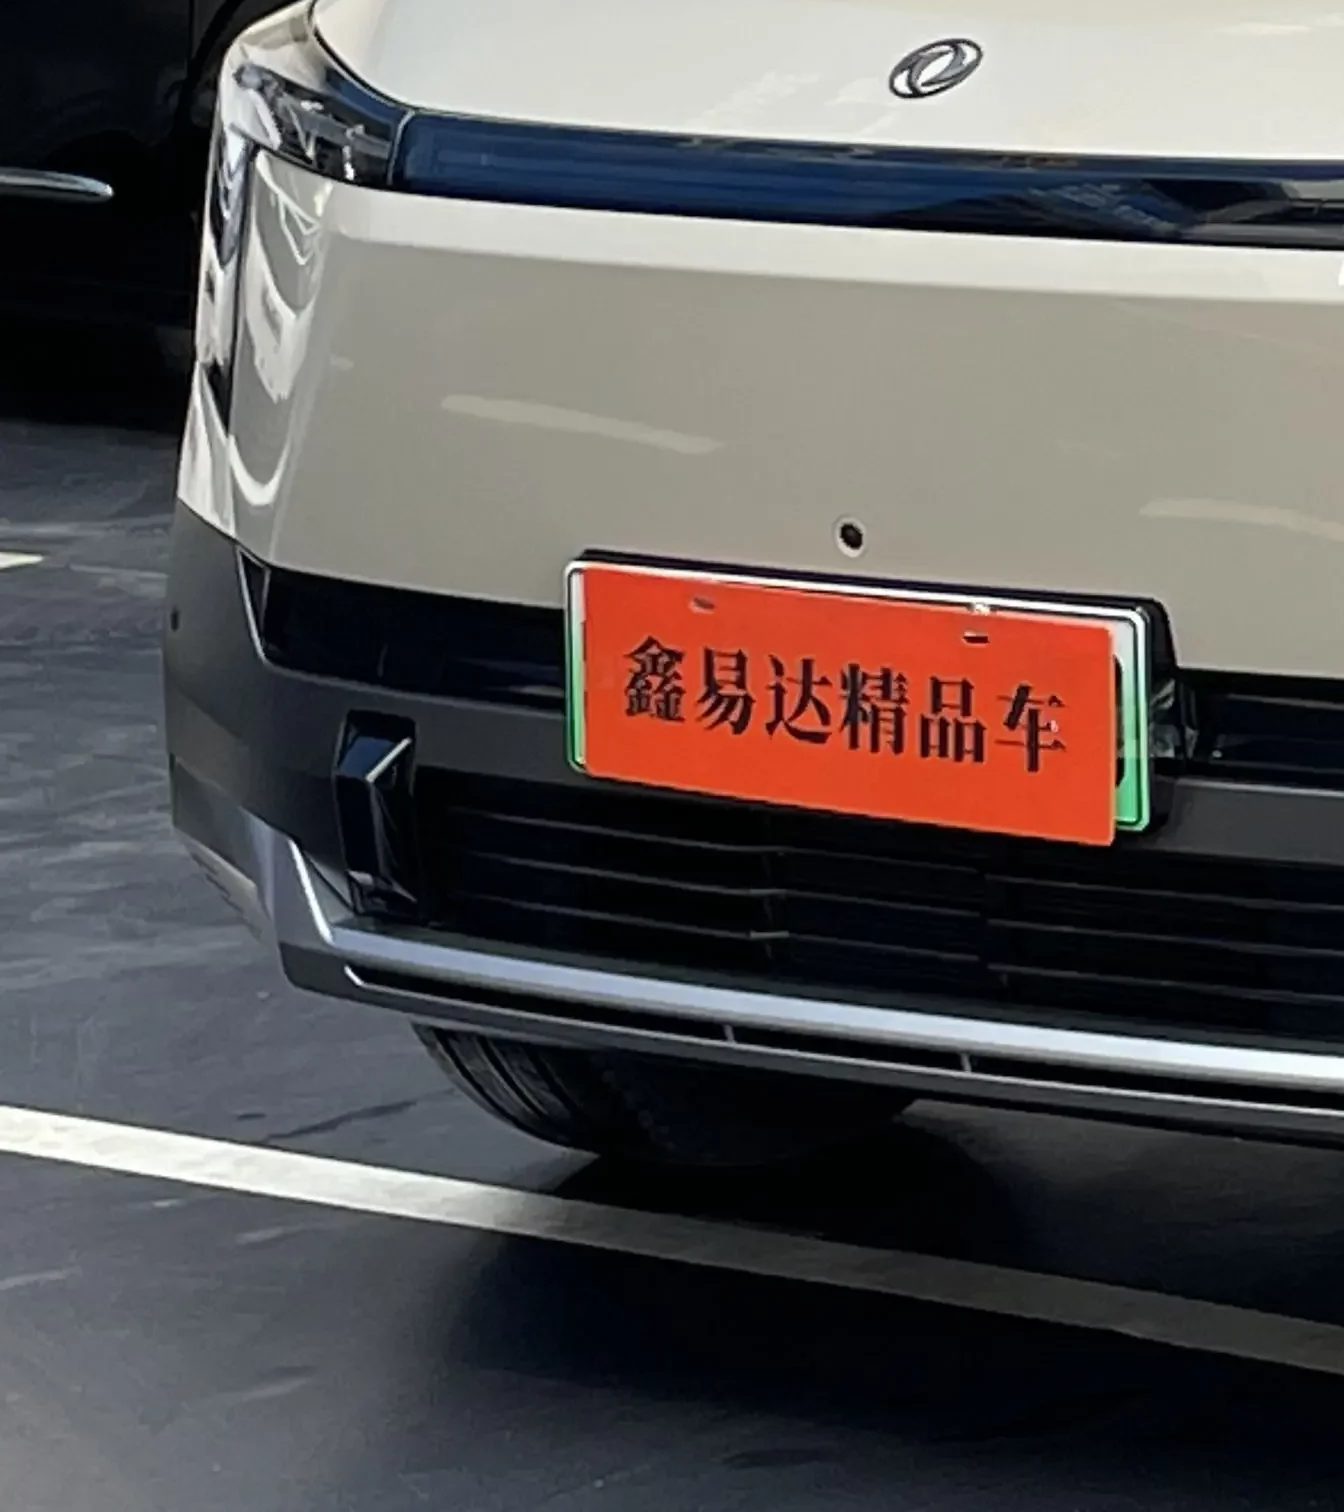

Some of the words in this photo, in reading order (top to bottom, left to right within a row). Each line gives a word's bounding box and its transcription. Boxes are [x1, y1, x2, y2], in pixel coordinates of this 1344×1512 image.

[624, 635, 1067, 773] 鑫易达精品车
